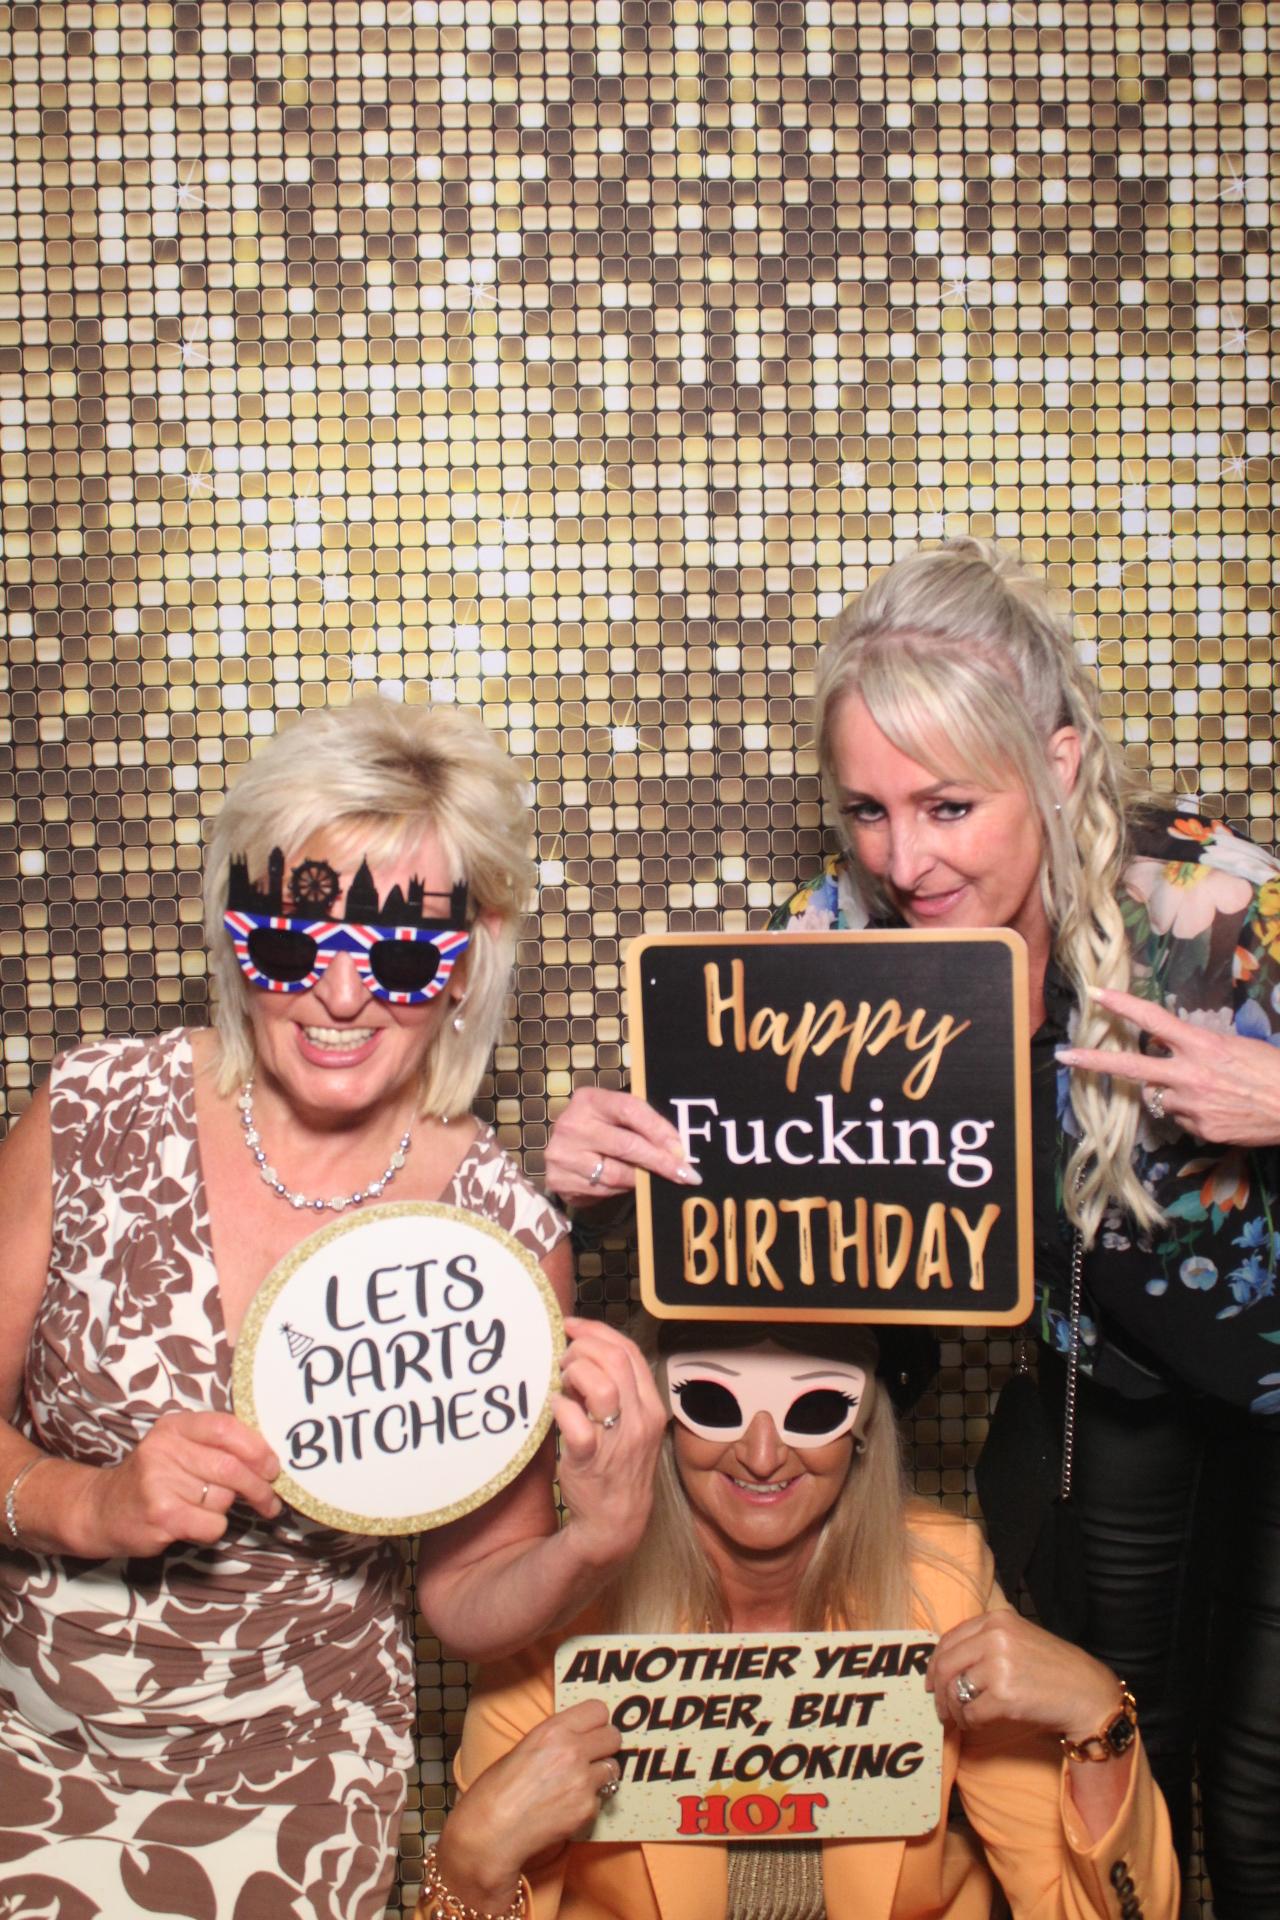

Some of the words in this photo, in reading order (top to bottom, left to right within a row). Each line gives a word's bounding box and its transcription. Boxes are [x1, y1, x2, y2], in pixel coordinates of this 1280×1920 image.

[704, 958, 971, 1100] Happy
[669, 1094, 994, 1188] Fucking
[682, 1197, 1001, 1291] BIRTHDAY
[325, 1254, 484, 1332] LETS
[299, 1319, 506, 1404] PARTY
[286, 1381, 530, 1470] BITCHES!
[561, 1645, 802, 1684] ANOTHER
[813, 1642, 939, 1678] YEAR
[611, 1693, 774, 1736] OLDER,
[788, 1692, 886, 1728] BUT
[613, 1747, 697, 1783] TILL
[709, 1741, 925, 1783] LOOKING
[676, 1793, 829, 1836] HOT
